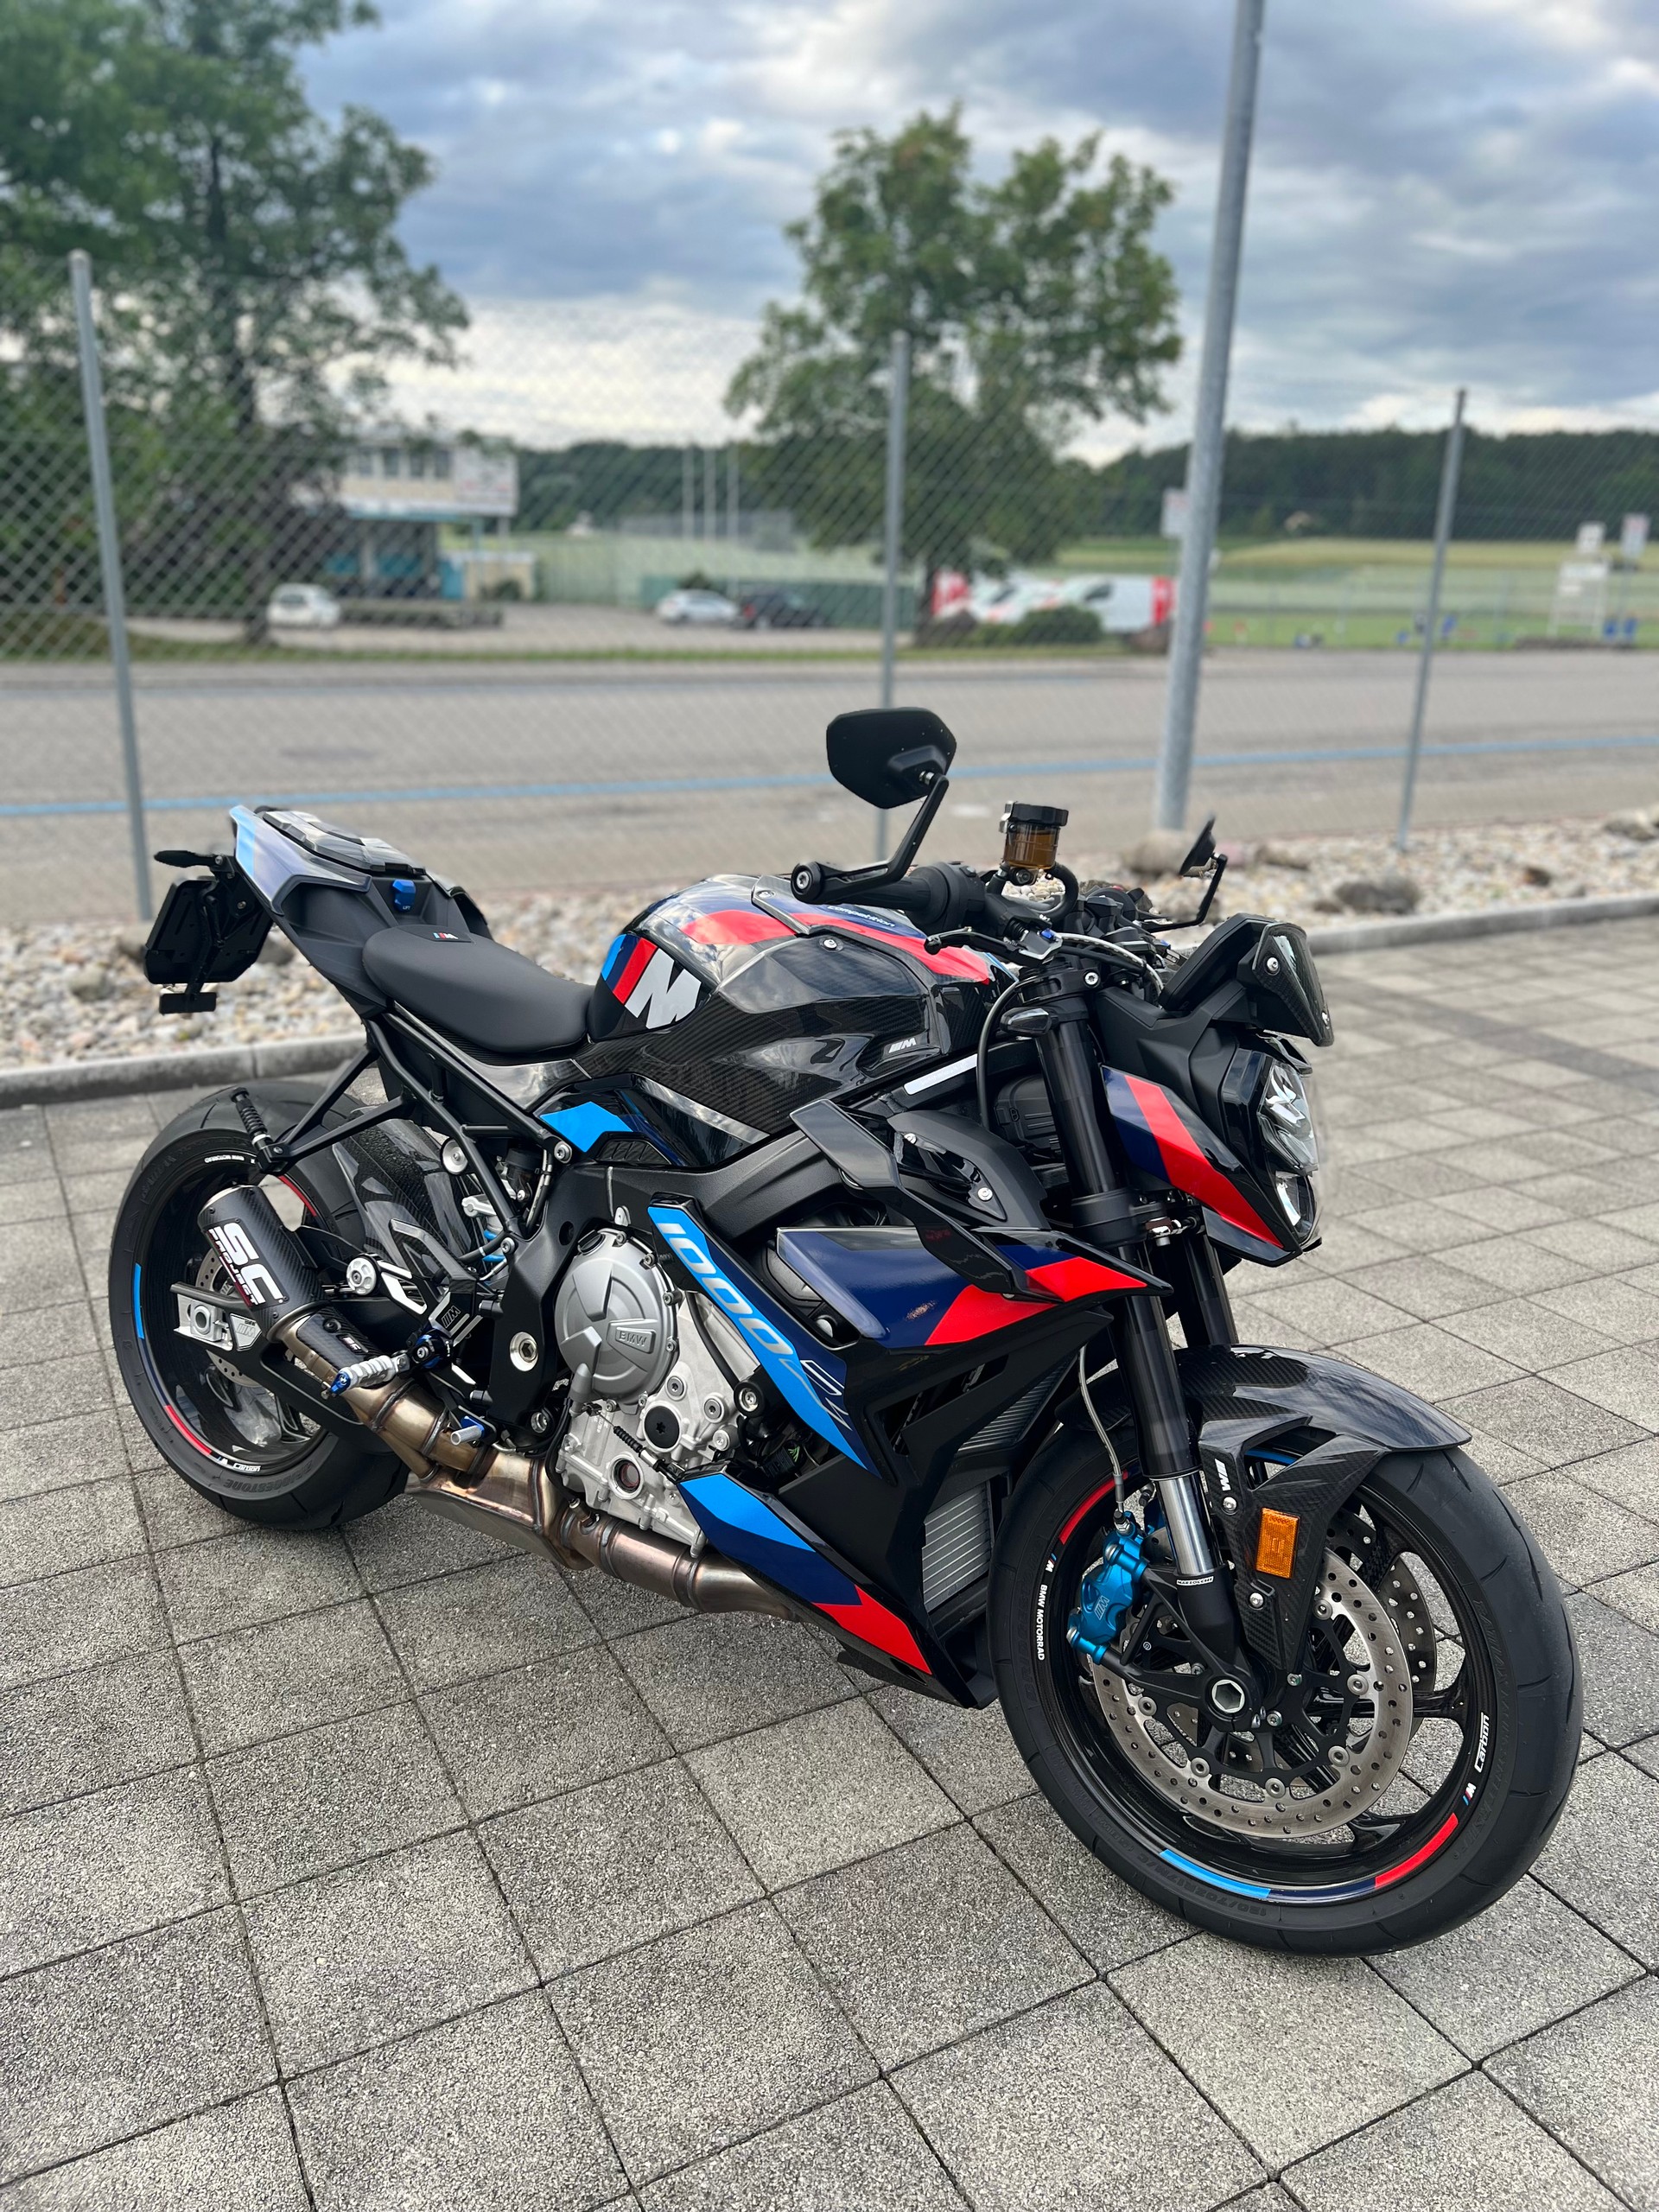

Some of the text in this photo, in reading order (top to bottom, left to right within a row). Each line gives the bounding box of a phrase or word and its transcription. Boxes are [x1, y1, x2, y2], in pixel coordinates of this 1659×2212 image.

[827, 906, 895, 927] competition
[625, 948, 702, 1029] M
[208, 1228, 259, 1306] PROJECT
[213, 1222, 284, 1304] SC
[657, 1223, 794, 1355] 1000
[619, 1331, 648, 1347] BMW
[232, 1462, 262, 1472] Carbon
[1036, 1584, 1048, 1661] BMW MOTORRAD
[1474, 1712, 1491, 1773] Carbon
